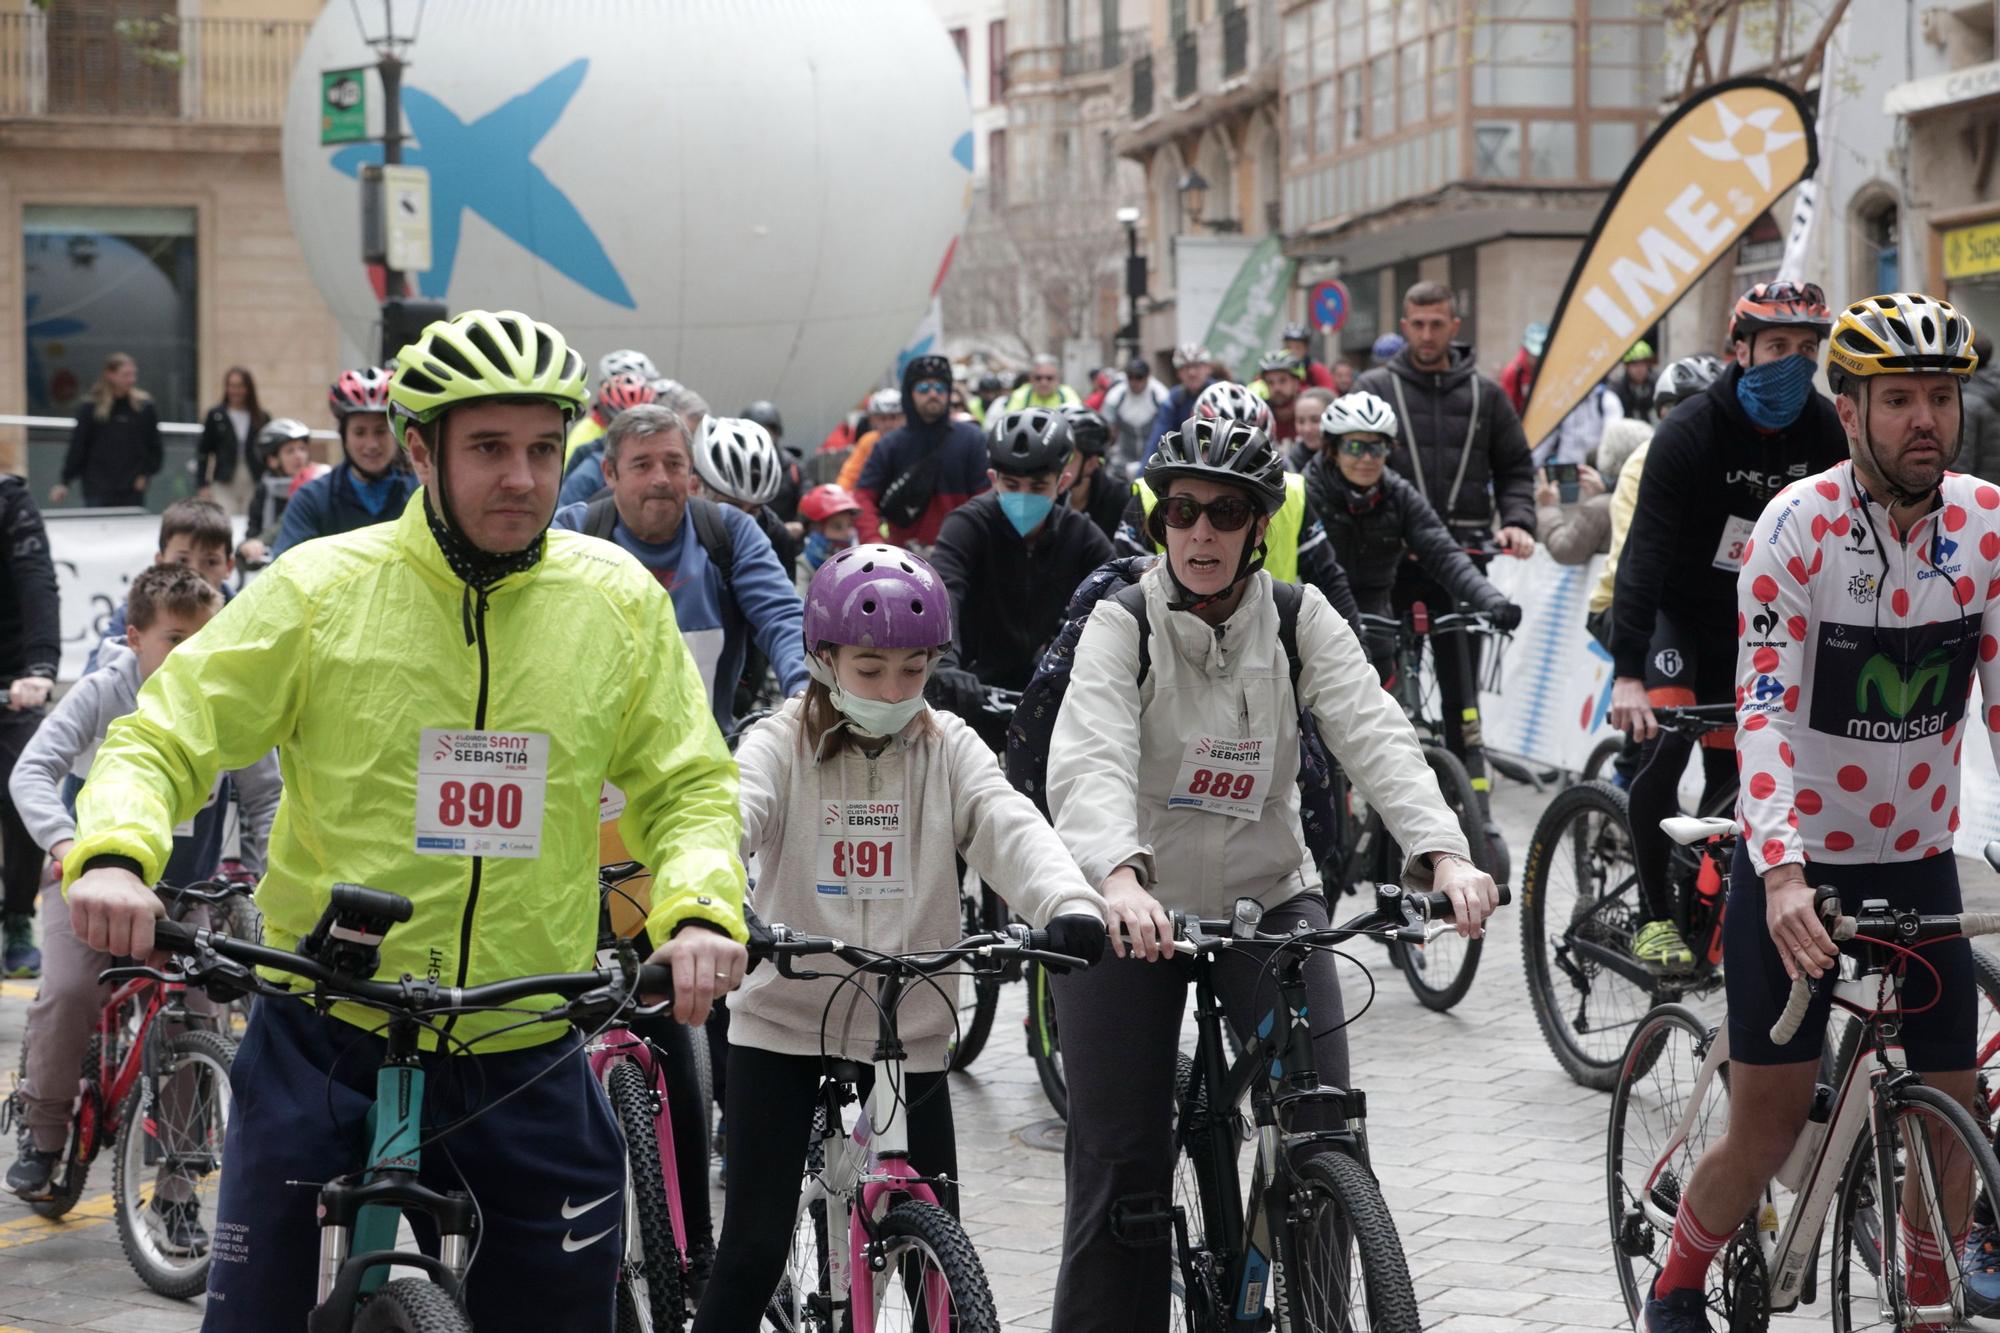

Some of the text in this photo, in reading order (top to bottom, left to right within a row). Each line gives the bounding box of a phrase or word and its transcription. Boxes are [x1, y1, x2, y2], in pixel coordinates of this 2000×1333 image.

[1768, 505, 1793, 545] Carrefour
[1825, 637, 1859, 651] Nalini
[1847, 711, 1947, 740] movistar
[489, 736, 529, 749] SANT
[1237, 741, 1262, 751] SANT
[454, 749, 528, 764] SEBASTIÀ
[1210, 749, 1260, 761] SEBASTIÀ
[1188, 769, 1255, 800] 889
[438, 781, 523, 829] 890
[869, 804, 900, 814] SANT
[841, 814, 899, 826] EBASTIÀ
[832, 840, 893, 878] 891
